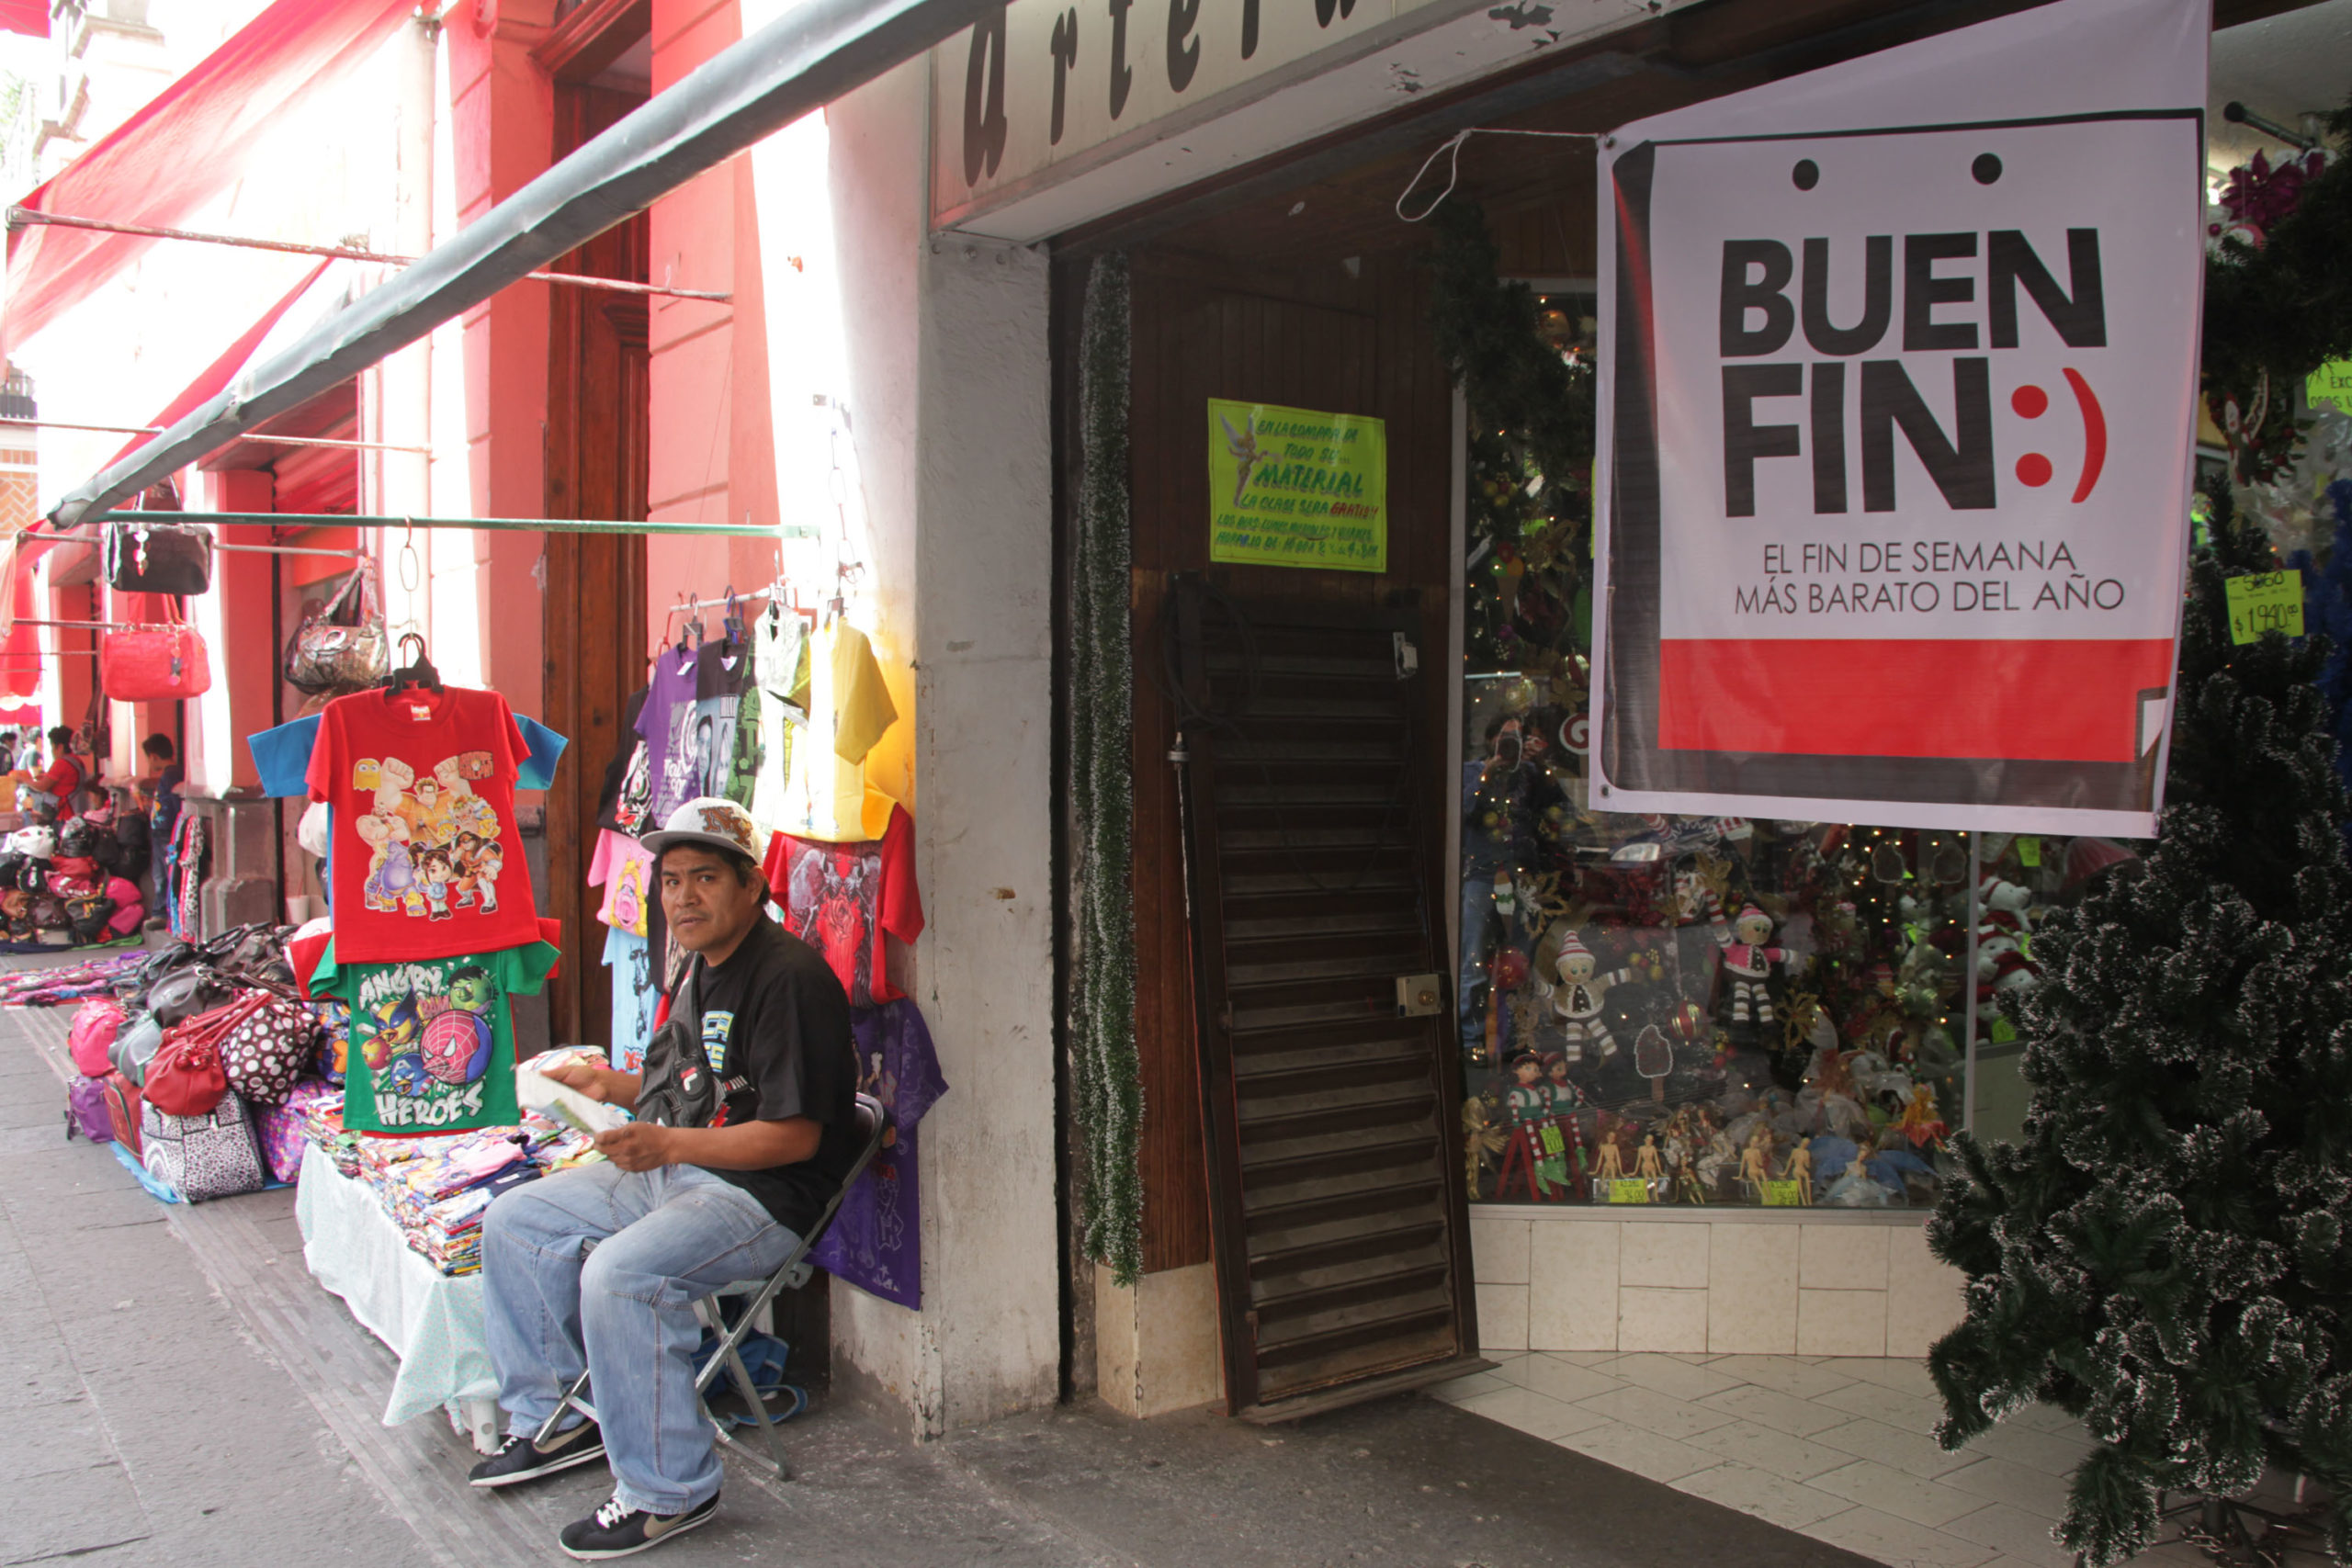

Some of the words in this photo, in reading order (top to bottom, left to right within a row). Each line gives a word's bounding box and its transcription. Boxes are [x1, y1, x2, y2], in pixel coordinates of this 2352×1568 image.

[1720, 228, 2107, 357] BUEN
[1283, 442, 1314, 460] TODO
[1253, 463, 1364, 498] MATERIAL
[1239, 493, 1258, 510] LA
[1259, 496, 1296, 513] CLASE
[1764, 544, 1792, 574] EL
[1803, 543, 1848, 573] FIN
[1860, 542, 1902, 572] DE
[1912, 540, 2077, 572] SEMANA
[1735, 576, 1797, 615] MÁS
[1809, 581, 1939, 614] BARATO
[1953, 580, 2020, 613] DEL
[2032, 573, 2124, 612] AÑO
[358, 964, 444, 1011] ANGRY
[374, 1080, 486, 1127] HEROES
